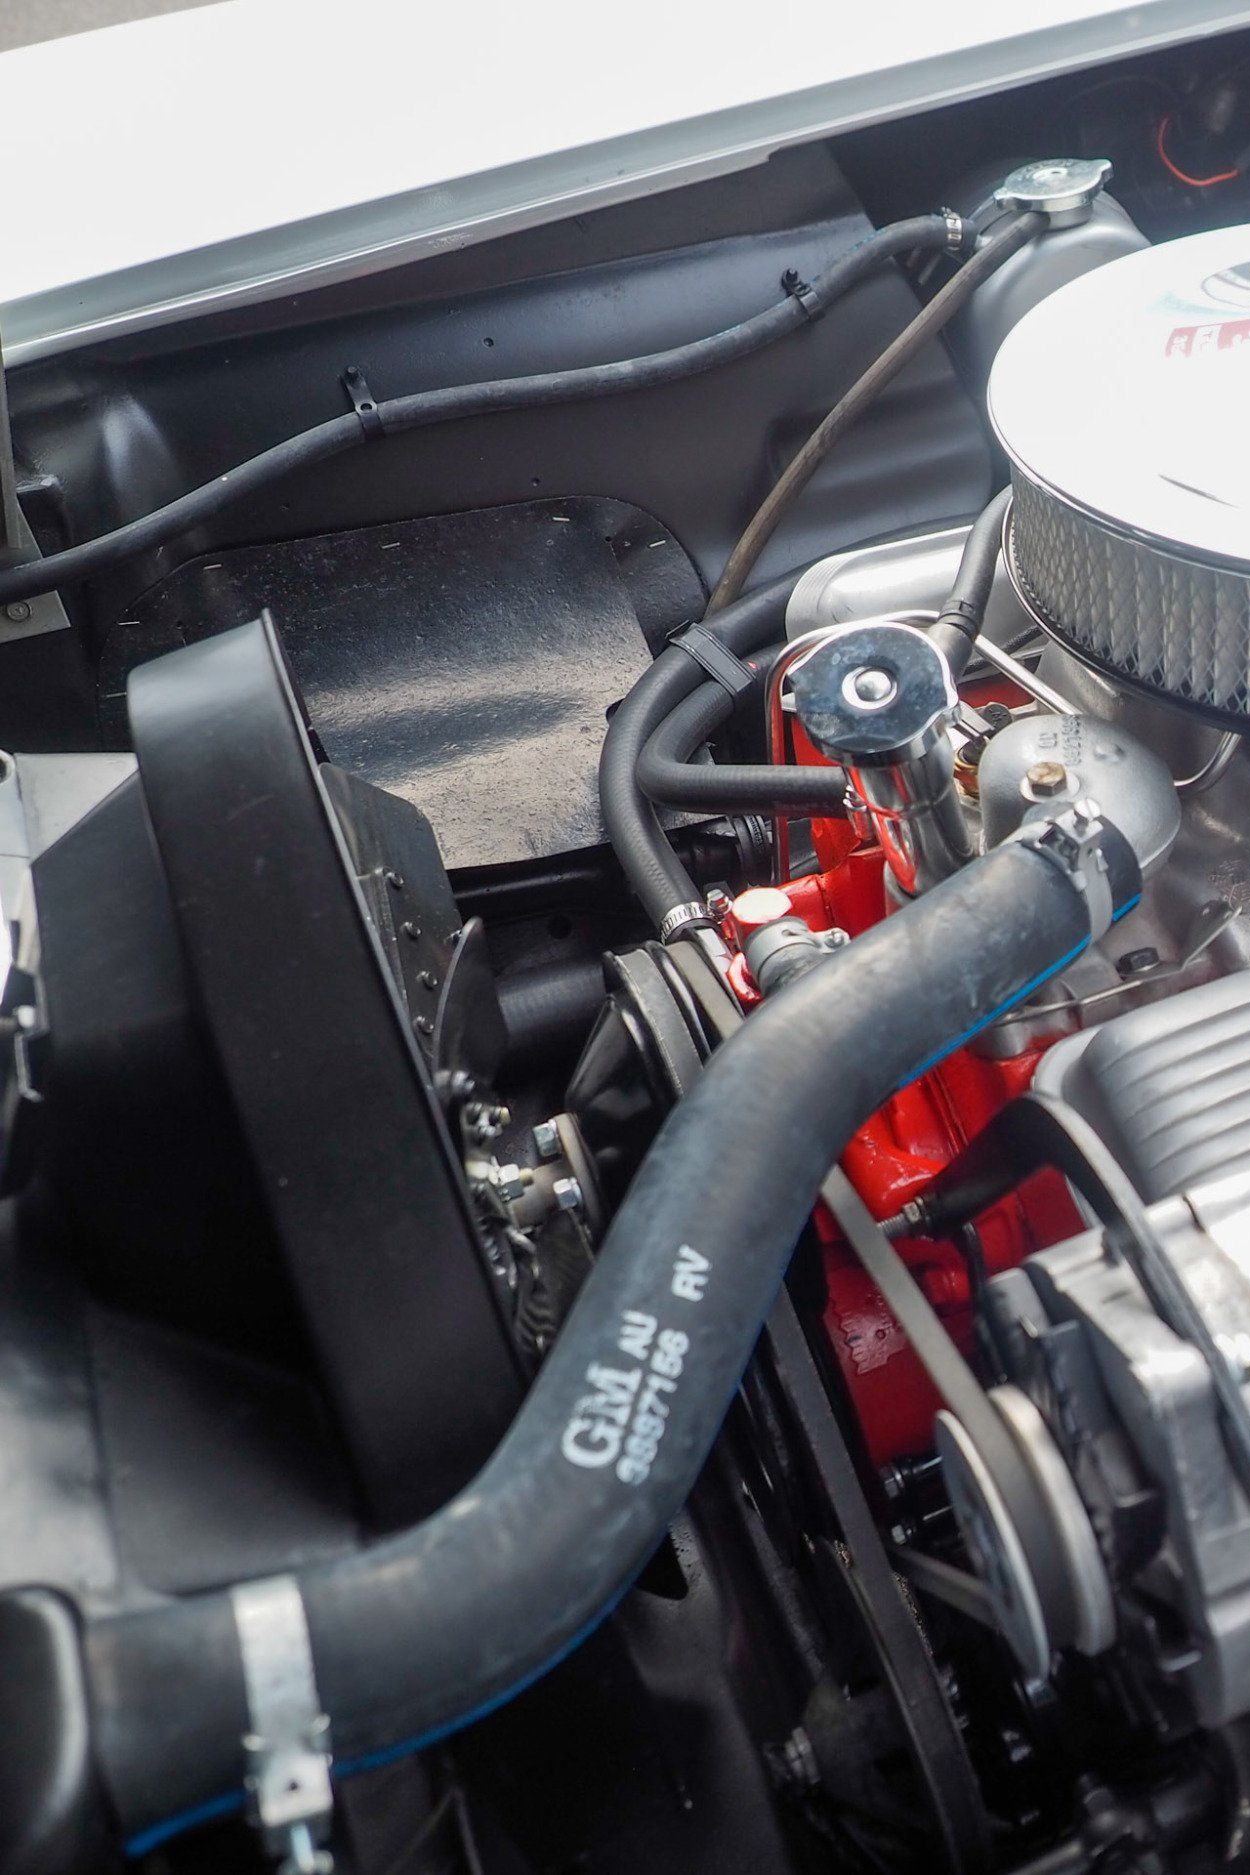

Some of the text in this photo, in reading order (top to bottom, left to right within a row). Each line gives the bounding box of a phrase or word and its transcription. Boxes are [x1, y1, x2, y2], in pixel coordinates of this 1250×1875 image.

[670, 1244, 711, 1302] RV
[561, 1310, 658, 1469] GM AU
